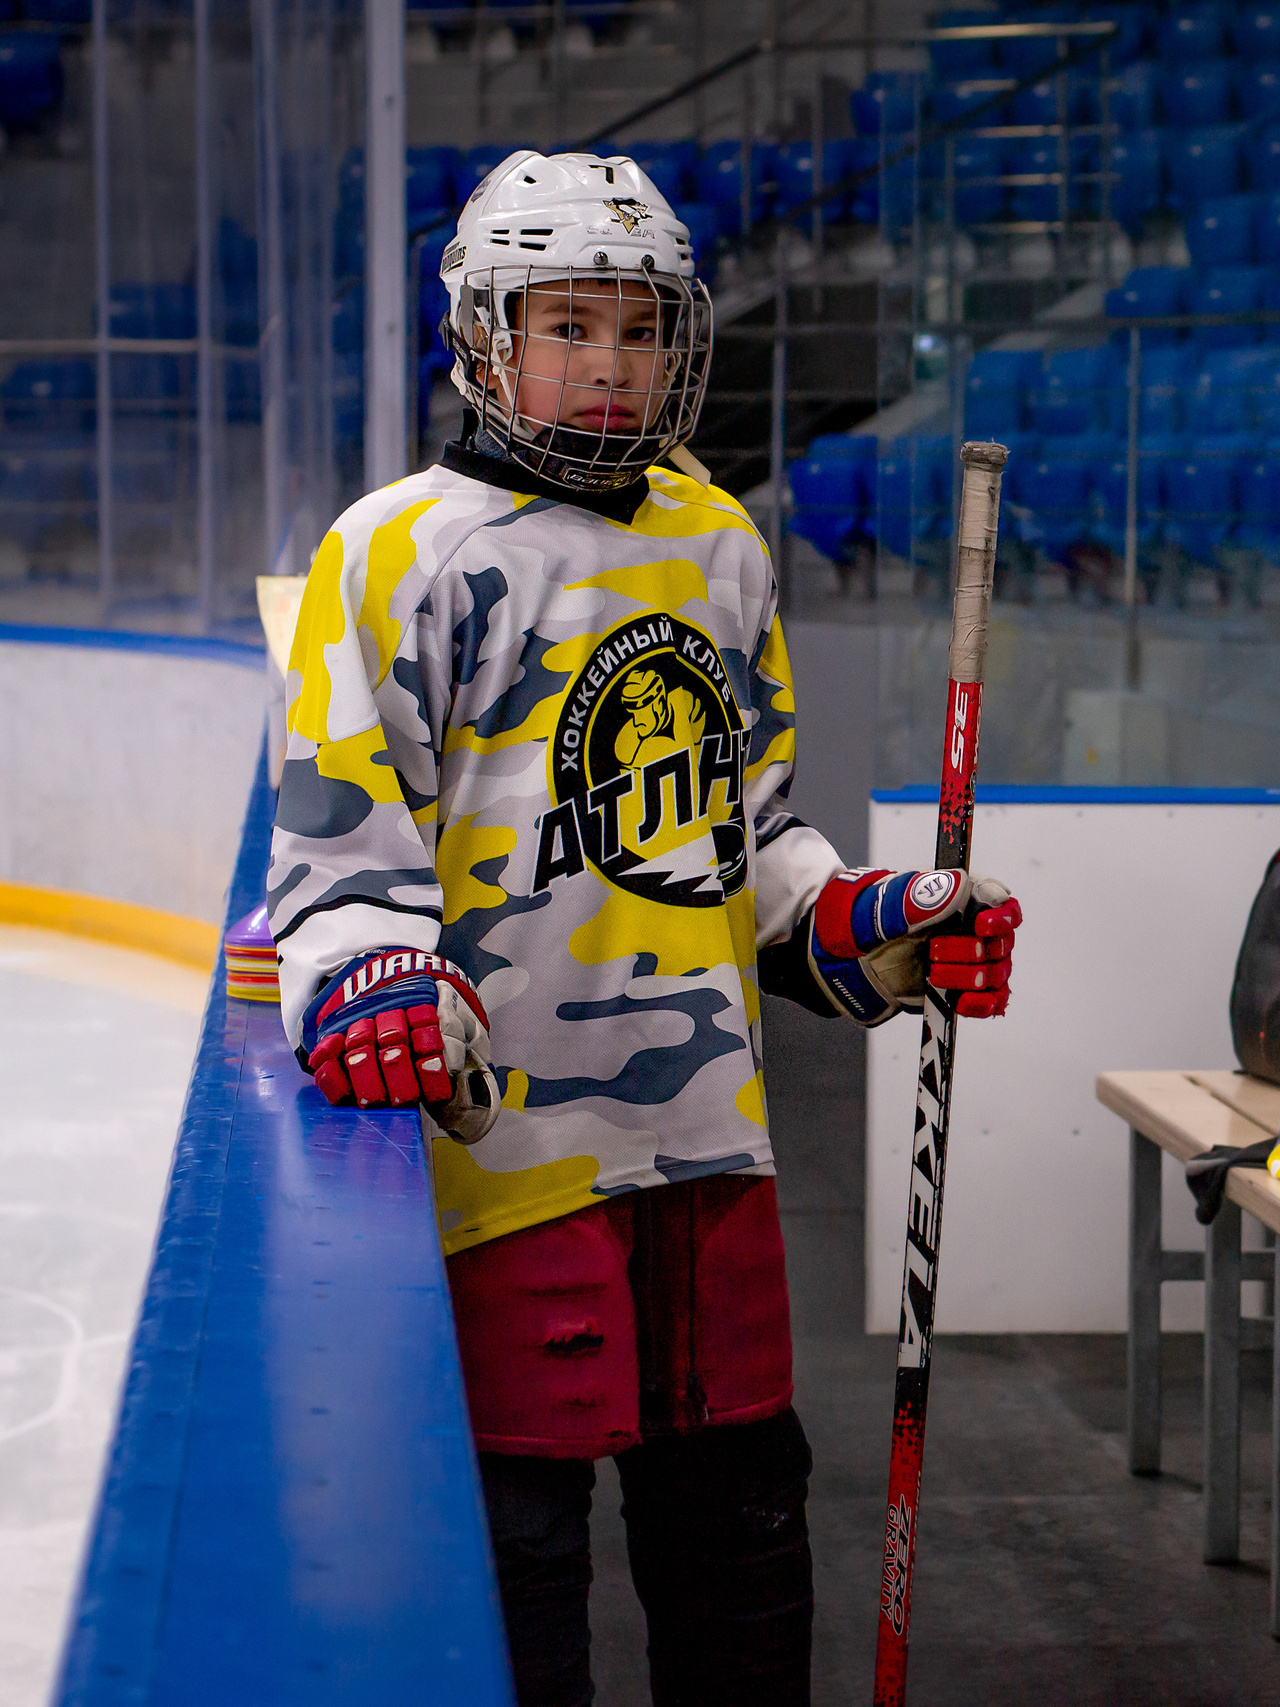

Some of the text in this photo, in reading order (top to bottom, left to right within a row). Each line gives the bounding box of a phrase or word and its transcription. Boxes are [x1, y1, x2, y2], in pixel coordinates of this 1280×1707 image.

[560, 615, 732, 772] ХОККЕЙНЫЙ КЛУБ
[880, 1503, 899, 1621] GRAVITY
[892, 1493, 912, 1636] ZERO
